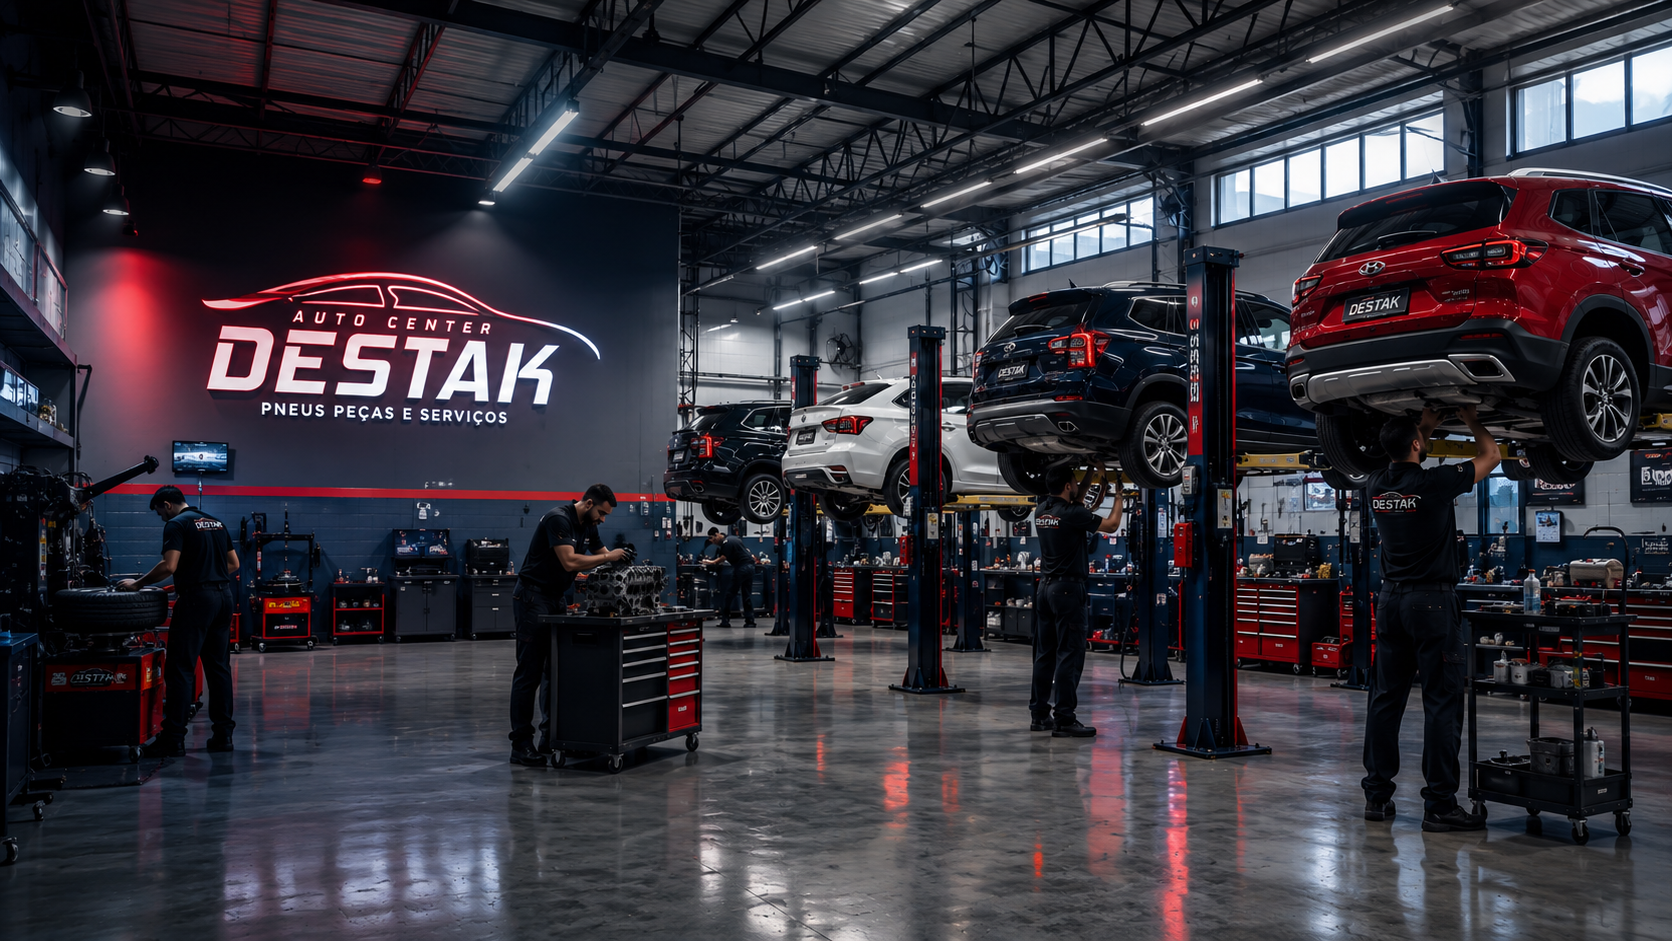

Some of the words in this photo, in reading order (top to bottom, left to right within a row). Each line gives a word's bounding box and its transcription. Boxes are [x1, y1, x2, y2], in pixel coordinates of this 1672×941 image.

[1349, 295, 1401, 316] DESTAK
[292, 310, 366, 327] AUTO
[387, 316, 492, 335] CENTER
[206, 325, 560, 405] DESTAK
[261, 402, 325, 418] PNEUS
[333, 404, 395, 423] PEÇAS
[402, 407, 413, 421] E
[420, 408, 508, 426] SERVIÇOS
[1372, 497, 1417, 510] DESTAK
